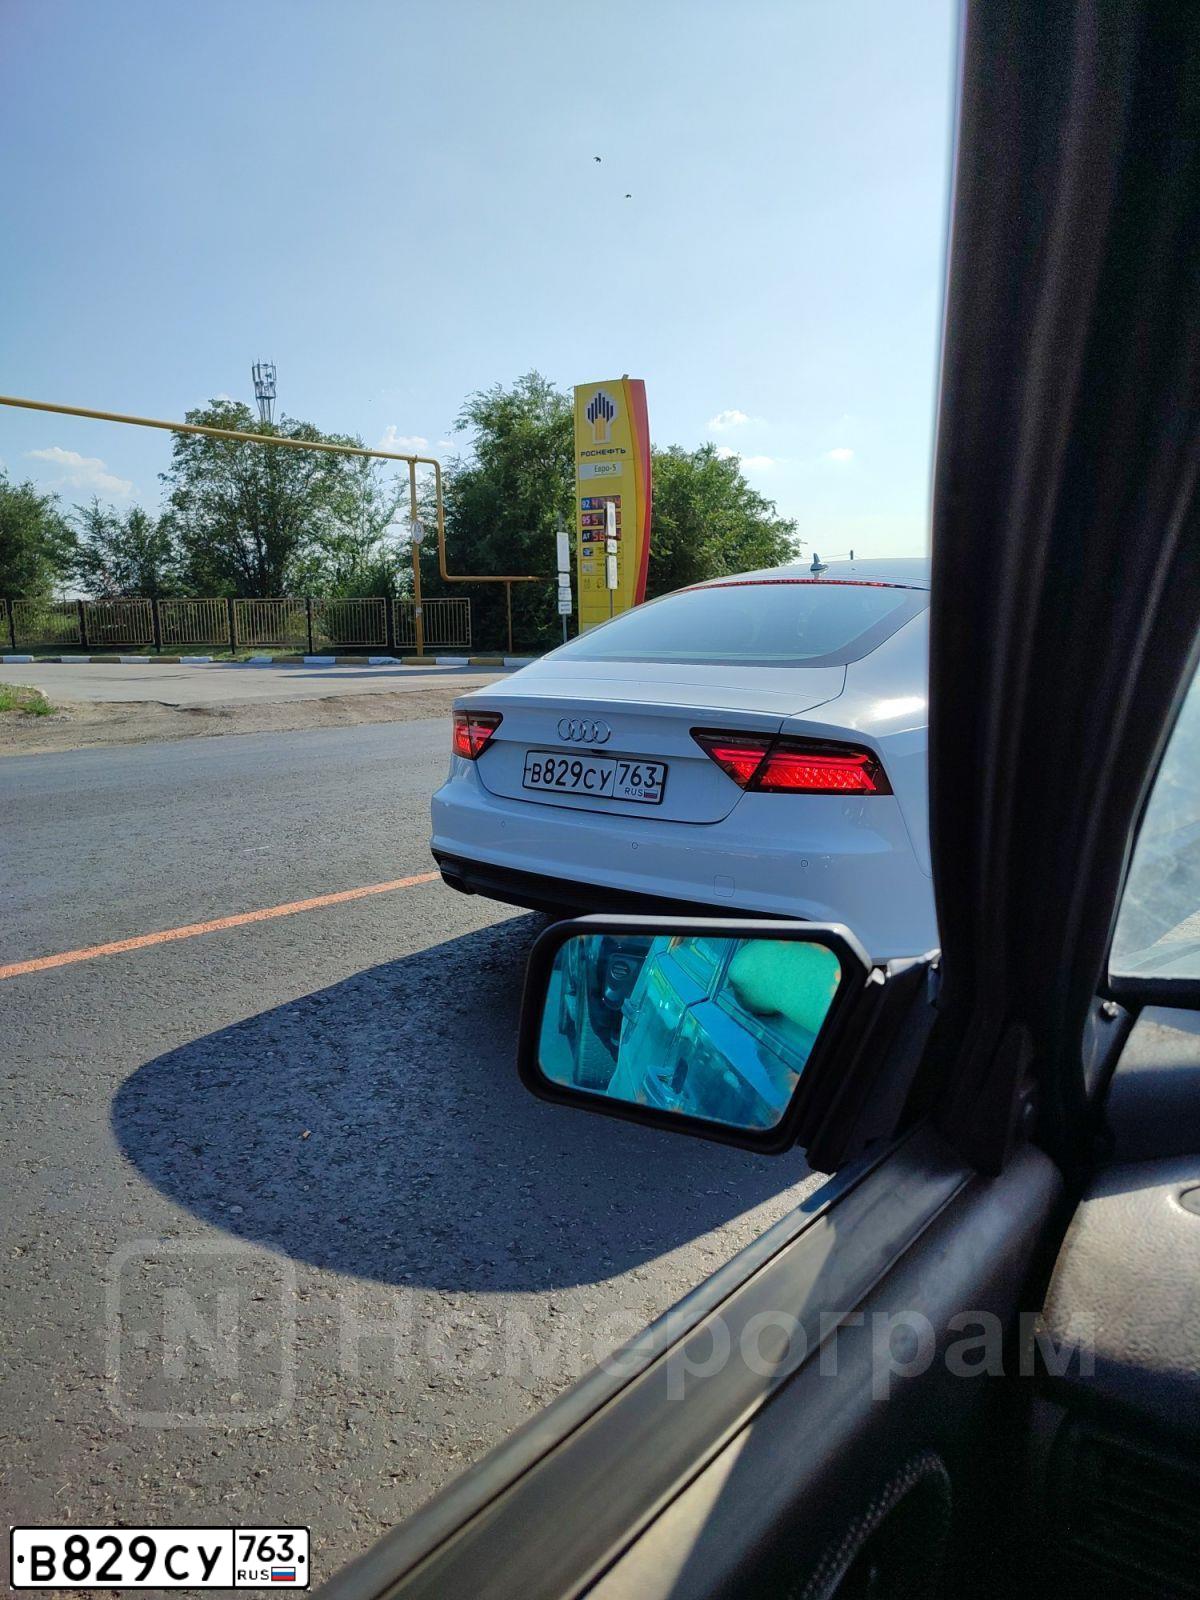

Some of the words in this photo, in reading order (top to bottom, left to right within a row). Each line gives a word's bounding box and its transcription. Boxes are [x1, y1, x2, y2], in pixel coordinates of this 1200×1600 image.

[580, 448, 626, 457] РОСНЕФТЬ
[594, 464, 617, 474] Евро-5
[582, 500, 591, 508] 92
[531, 759, 612, 791] В829СУ
[619, 763, 657, 788] 763
[624, 787, 643, 797] RUS
